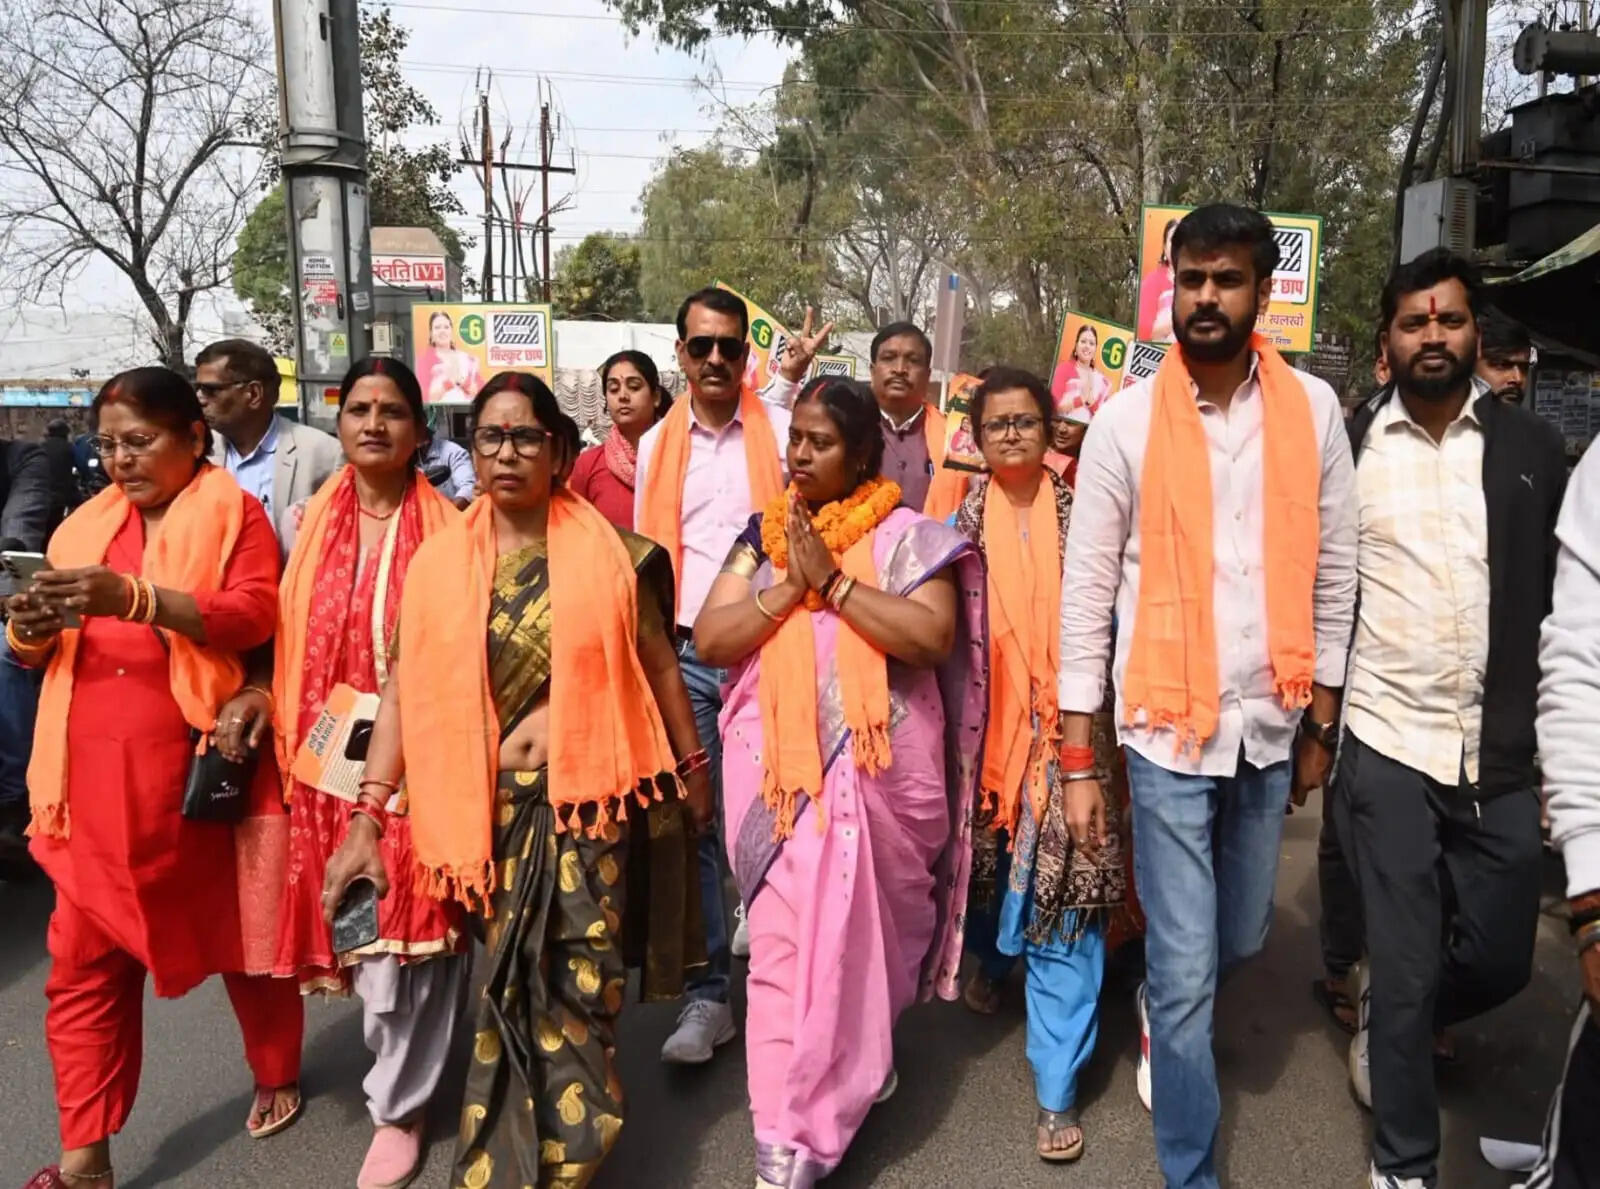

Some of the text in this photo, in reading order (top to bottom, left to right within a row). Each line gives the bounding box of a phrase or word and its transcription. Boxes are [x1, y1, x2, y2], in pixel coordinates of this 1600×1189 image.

[415, 264, 443, 279] IVF
[1281, 278, 1304, 294] छाप
[468, 318, 482, 341] 6
[759, 326, 770, 345] 6
[1110, 343, 1123, 366] 6
